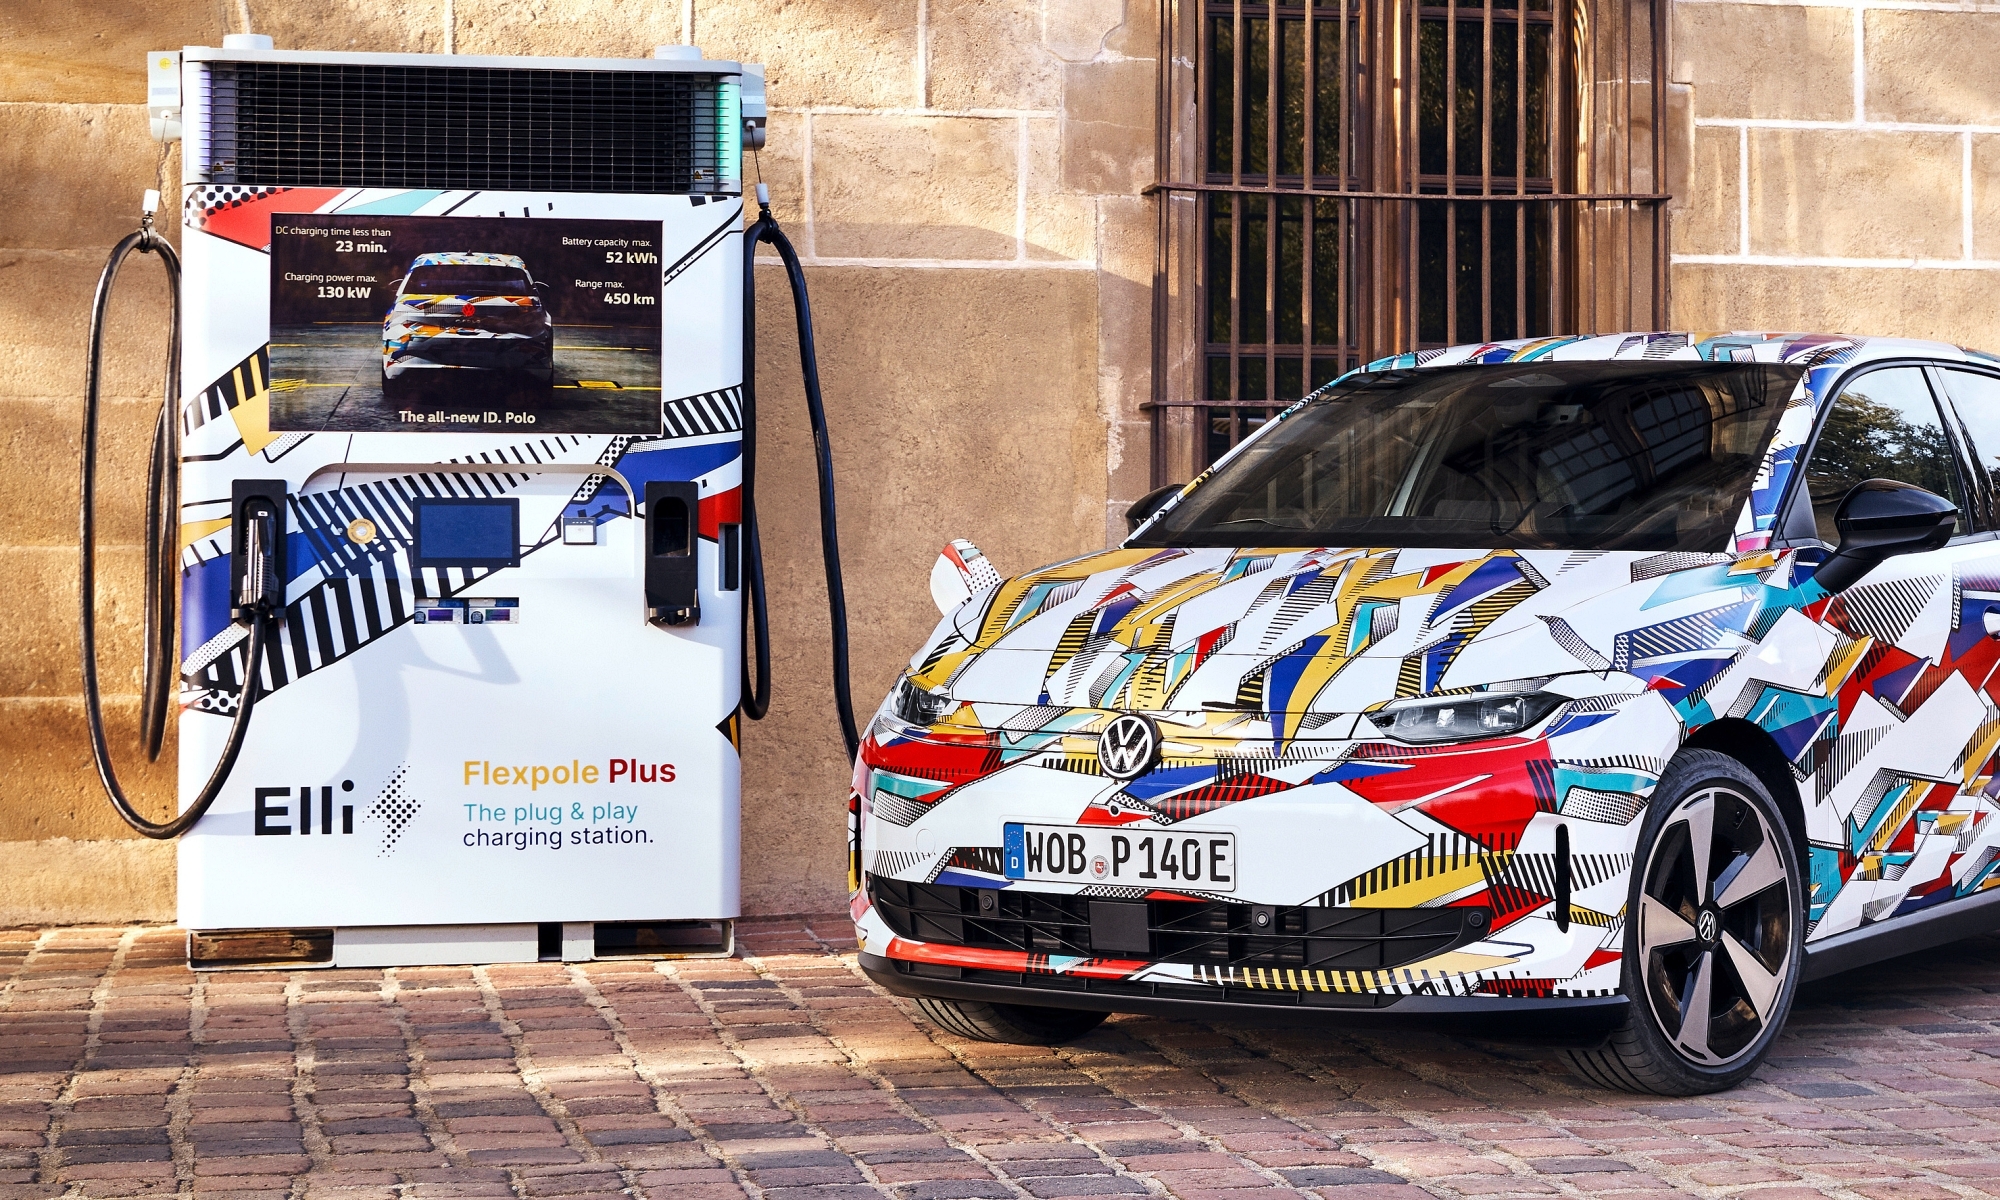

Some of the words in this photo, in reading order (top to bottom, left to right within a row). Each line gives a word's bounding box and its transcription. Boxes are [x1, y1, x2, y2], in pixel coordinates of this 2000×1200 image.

[276, 226, 288, 234] DC
[291, 227, 328, 237] charging
[353, 228, 369, 236] less
[336, 241, 353, 252] 23
[357, 241, 387, 253] min.
[563, 237, 592, 247] Battery
[594, 239, 628, 248] capacity
[606, 252, 623, 263] 52
[627, 252, 657, 264] kWh
[285, 272, 323, 283] Charging
[326, 275, 355, 284] power
[576, 280, 602, 289] Range
[318, 286, 344, 298] 130
[348, 287, 371, 298] kW
[604, 293, 630, 304] 450
[634, 293, 654, 304] km
[399, 411, 424, 422] The
[428, 411, 480, 423] all-new
[484, 412, 501, 423] ID.
[506, 412, 535, 423] Polo
[464, 760, 599, 791] Flexpole
[610, 759, 676, 783] Plus
[255, 780, 354, 835] Elli
[464, 804, 505, 821] The
[515, 803, 561, 825] plug
[571, 802, 584, 820] &
[593, 802, 638, 824] play
[464, 827, 561, 850] charging
[571, 826, 653, 844] station.
[1026, 832, 1086, 874] WOB
[1012, 857, 1018, 868] D
